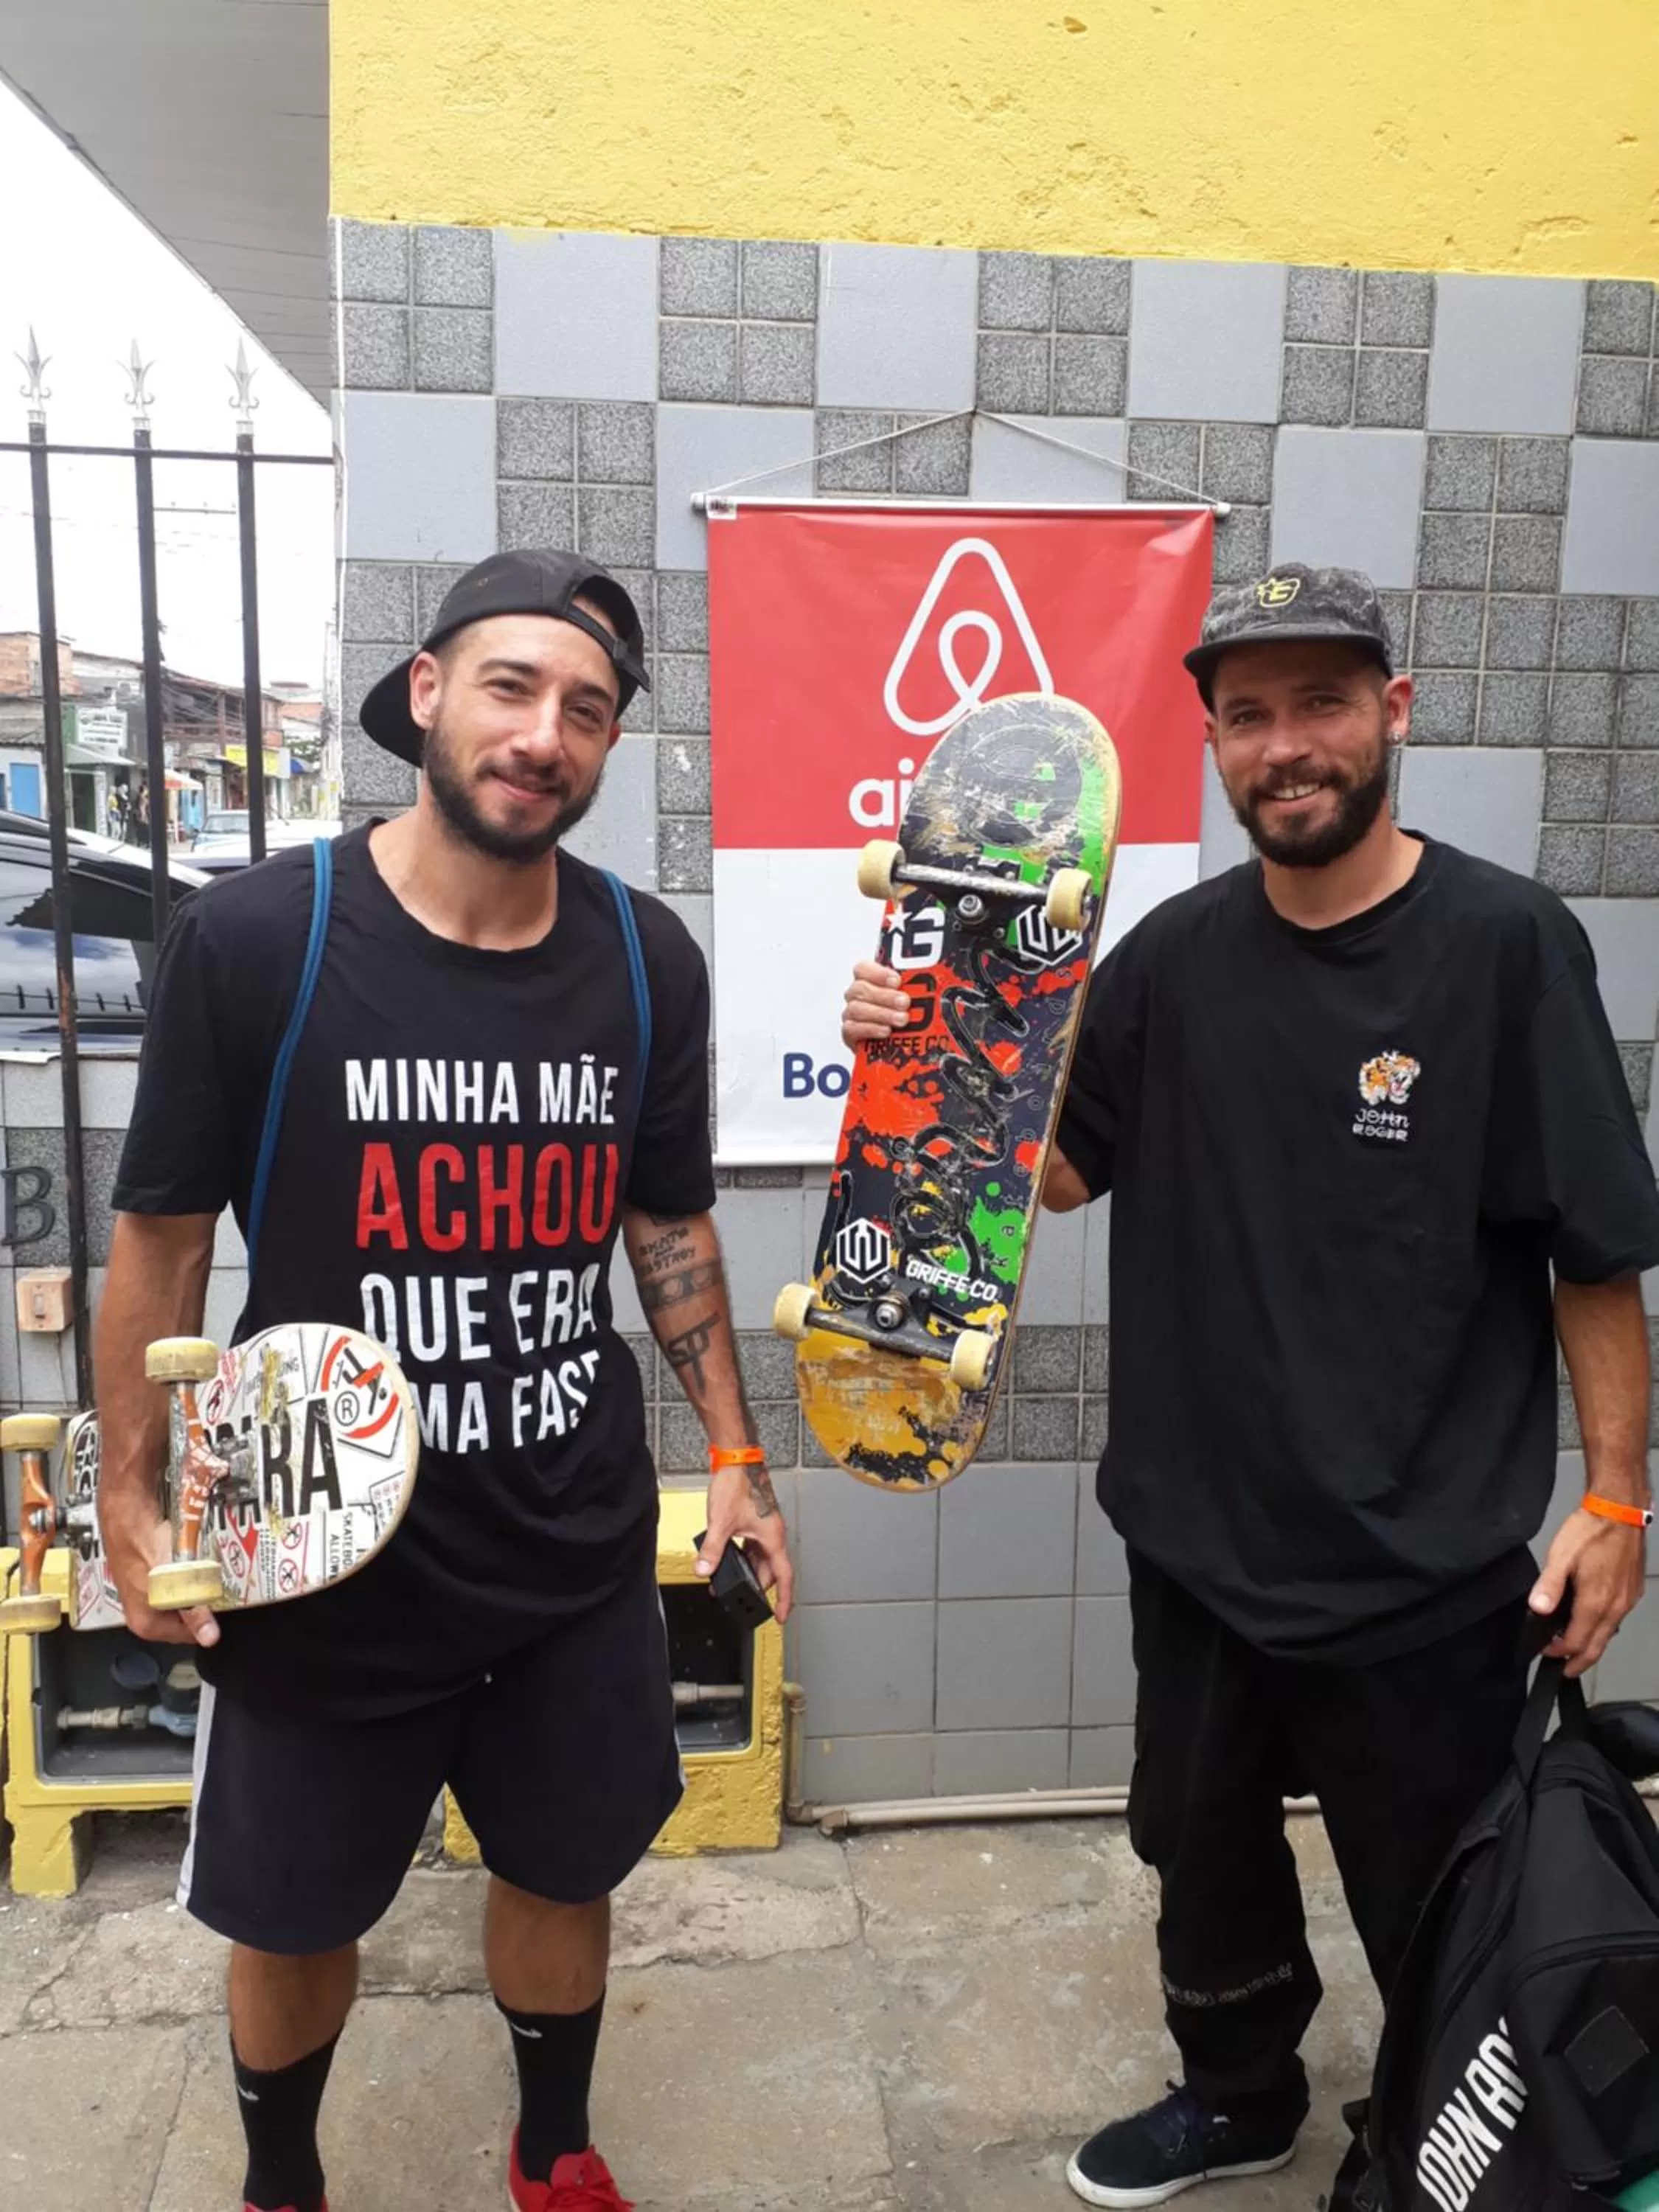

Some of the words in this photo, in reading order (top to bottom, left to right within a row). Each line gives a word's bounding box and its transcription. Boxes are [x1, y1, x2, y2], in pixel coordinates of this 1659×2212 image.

[848, 757, 915, 827] ai
[344, 1059, 520, 1124] MINHA
[538, 1054, 619, 1124] MÃE
[782, 1052, 851, 1098] Bo
[1, 1166, 56, 1246] B
[355, 1142, 619, 1251] ACHOU
[360, 1273, 492, 1363] QUE
[509, 1263, 600, 1355] ERA
[407, 1381, 490, 1454] MA
[342, 1512, 353, 1571] SKATEBO
[1464, 2015, 1529, 2130] RO
